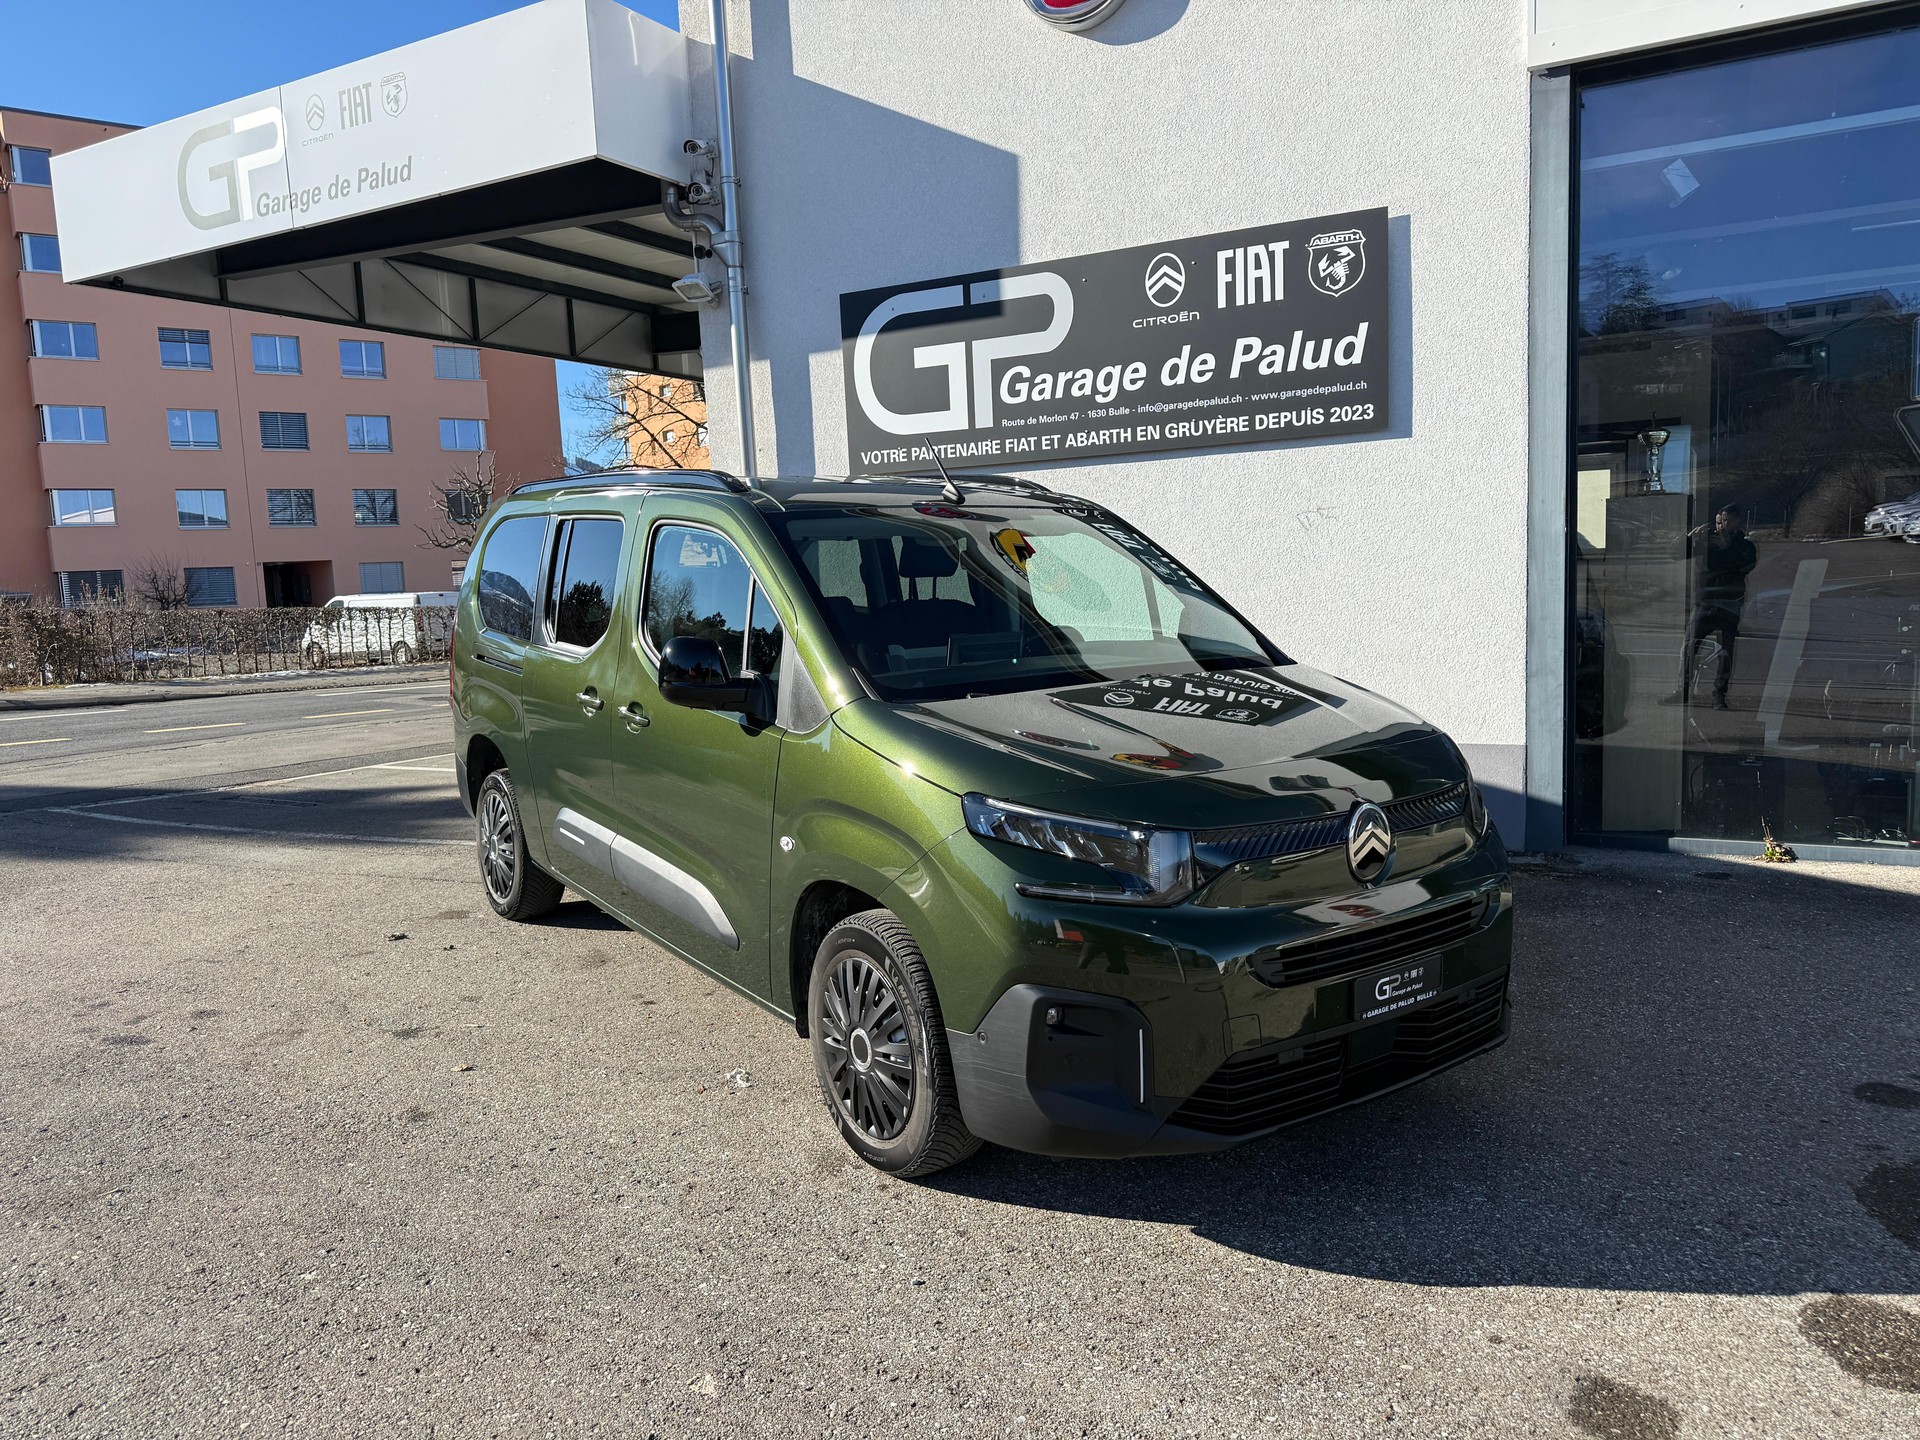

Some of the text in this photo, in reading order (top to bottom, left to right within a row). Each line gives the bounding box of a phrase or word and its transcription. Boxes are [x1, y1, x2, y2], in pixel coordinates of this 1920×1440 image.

[338, 82, 372, 130] FIAT
[177, 106, 288, 230] GP
[256, 155, 413, 218] Garage de Palud
[1312, 233, 1360, 247] ABARTH
[1216, 240, 1290, 309] FIAT
[854, 272, 1074, 435] GP
[999, 321, 1370, 405] Garage de Palud
[860, 403, 1375, 465] VOTRE PARTENAIRE FIAT ET ABARTH EN GRUYÈRE DEPUIS 2023
[1002, 418, 1025, 428] Route
[1026, 416, 1038, 425] de
[1039, 413, 1068, 424] Morlon
[1070, 412, 1080, 420] 47
[1087, 408, 1107, 419] 1630
[1108, 406, 1130, 416] Bulle
[1137, 394, 1243, 413] info@garagedepalud.ch
[1250, 380, 1368, 401] www.garagedepalud.ch
[1367, 990, 1433, 1018] GARAGE DE PALUD BULLE
[1375, 973, 1401, 1001] GP
